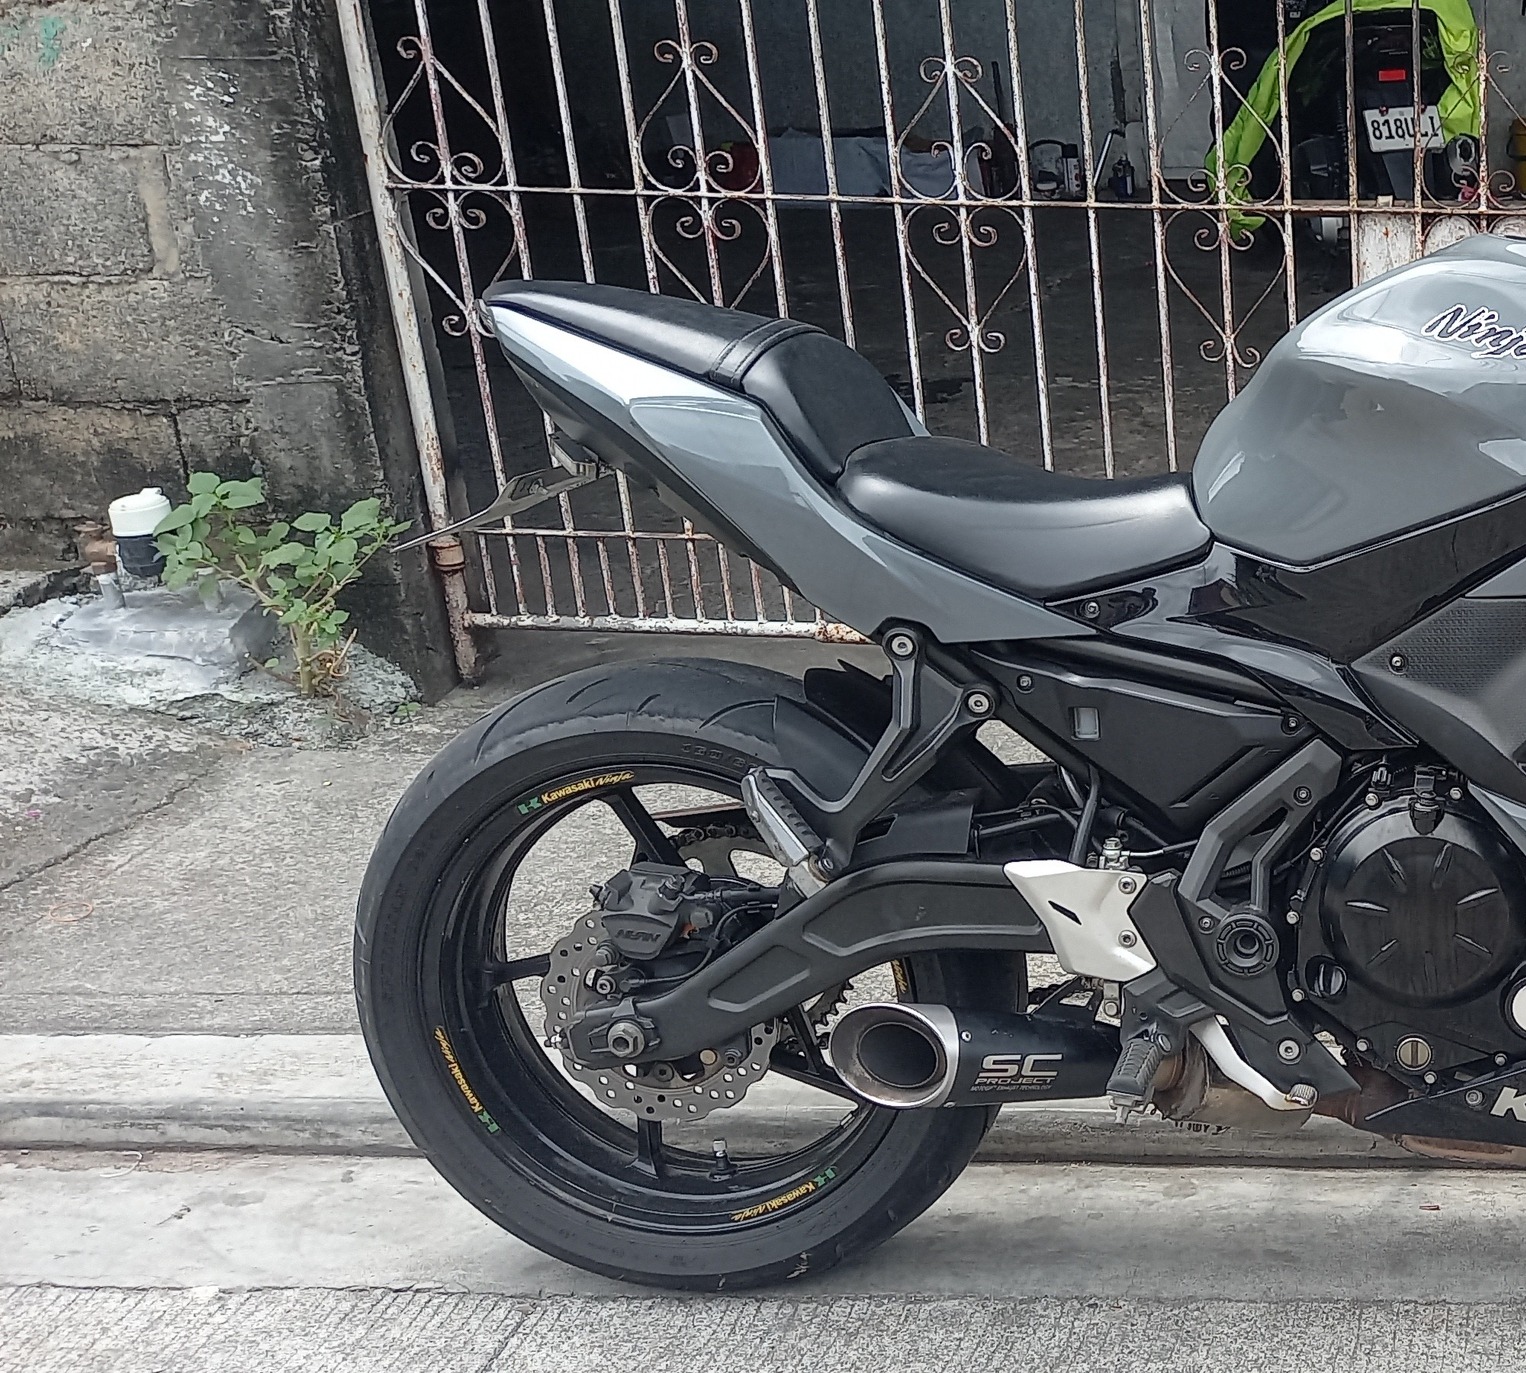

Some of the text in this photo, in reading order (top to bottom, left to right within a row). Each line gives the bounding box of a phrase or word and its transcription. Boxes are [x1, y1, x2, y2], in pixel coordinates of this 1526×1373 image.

[541, 770, 635, 803] Kawasaki Ninja
[979, 1053, 1063, 1077] SC
[448, 1062, 483, 1113] Kawasaki
[974, 1077, 1056, 1085] PROJECT
[765, 1181, 816, 1212] Kawasaki
